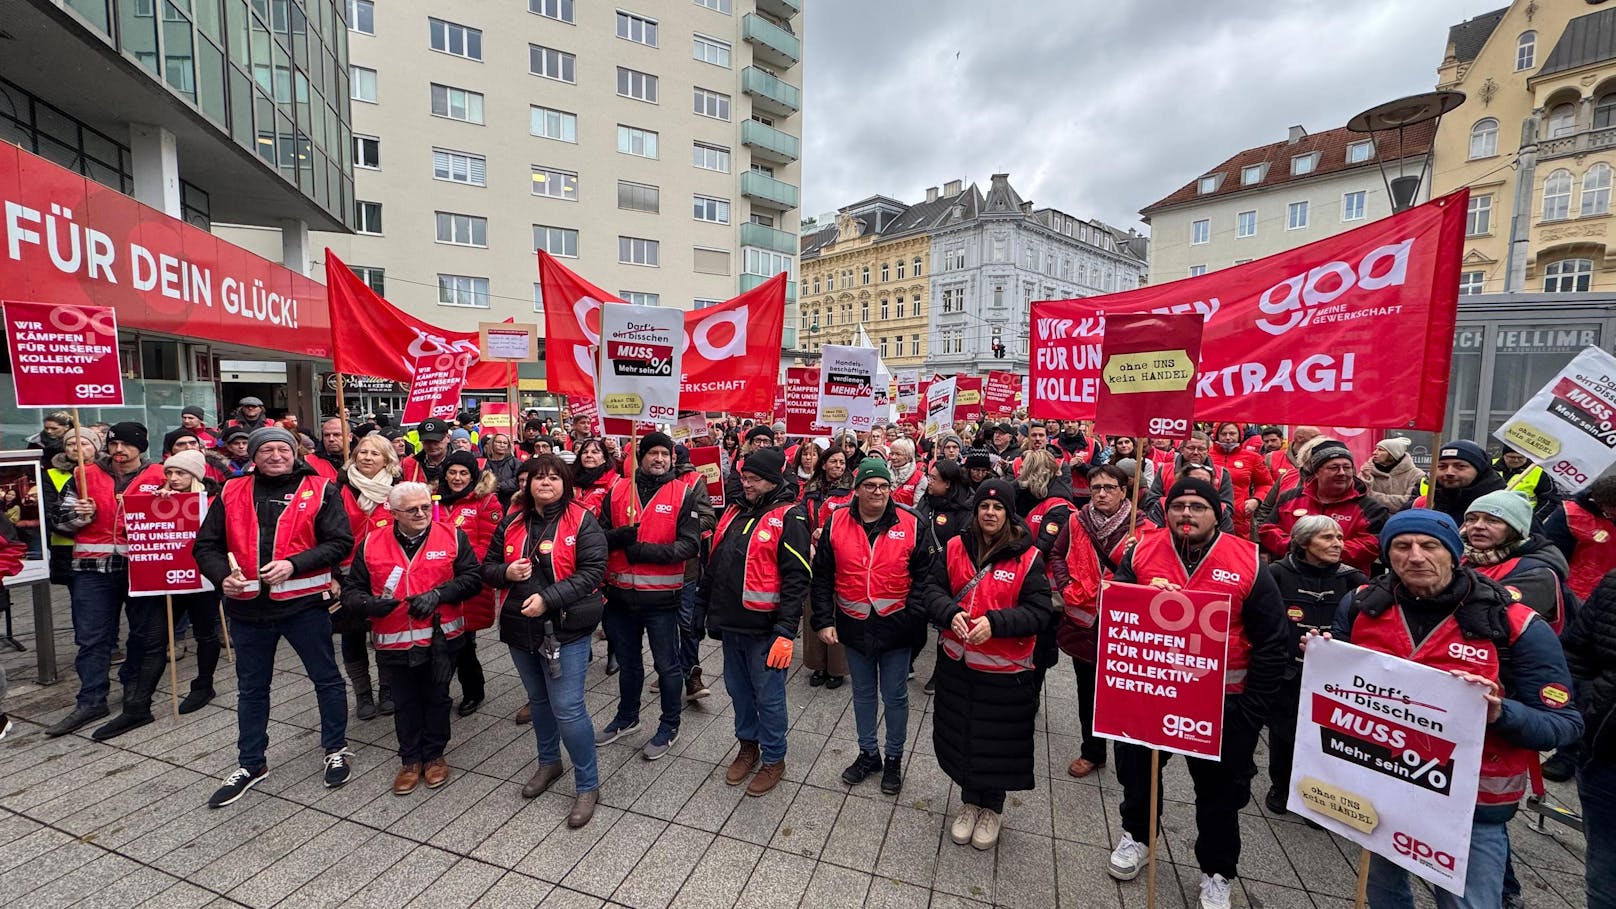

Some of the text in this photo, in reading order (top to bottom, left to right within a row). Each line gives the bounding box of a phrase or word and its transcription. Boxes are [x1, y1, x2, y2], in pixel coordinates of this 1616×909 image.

[5, 200, 299, 330] FÜR DEIN GLÜCK!
[1255, 238, 1416, 336] gpa
[1313, 305, 1402, 325] GEWERKSCHAFT
[1316, 304, 1347, 317] MEINE
[14, 321, 42, 330] WIR
[1037, 318, 1073, 341] WIR
[16, 331, 83, 342] KÄMPFEN
[629, 333, 669, 343] bisschen
[18, 342, 112, 353] FÜR UNSEREN
[617, 345, 653, 358] MUSS
[19, 354, 99, 363] KOLLEKTIV-
[1037, 342, 1069, 371] FÜR
[21, 366, 84, 374] VERTRAG
[618, 357, 671, 375] Mehr sein %
[830, 367, 869, 375] beschäftigte
[1119, 360, 1175, 371] ohne UNS
[417, 371, 448, 380] KÄMPFEN
[833, 376, 864, 384] verdienen
[1109, 371, 1188, 383] kein HANDEL
[415, 379, 428, 388] FÜR
[429, 377, 460, 386] UNSEREN
[679, 380, 746, 392] ERKSCHAFT
[787, 385, 818, 393] KÄMPFEN
[75, 384, 115, 398] gpa
[413, 385, 452, 395] KOLLEKTIV-
[831, 385, 858, 396] MEHR!
[858, 384, 872, 396] %
[412, 394, 442, 402] VERTRAG
[1566, 388, 1614, 420] MUSS
[432, 404, 454, 416] gpa
[649, 405, 674, 419] gpa
[852, 416, 869, 425] gpa
[1149, 418, 1187, 435] gpa
[1555, 404, 1579, 423] Mehr
[1579, 417, 1600, 438] sein
[1518, 427, 1536, 439] ohne
[1552, 460, 1588, 484] gpa
[461, 508, 477, 516] gpa
[655, 504, 672, 513] gpa
[126, 512, 146, 520] WIR
[127, 521, 175, 531] KÄMPFEN
[128, 531, 197, 541] FÜR UNSEREN
[888, 529, 905, 540] gpa
[128, 542, 187, 552] KOLLEKTIV-
[129, 553, 173, 562] VERTRAG
[426, 551, 446, 560] gpa
[166, 569, 195, 584] gpa
[993, 569, 1015, 583] gpa
[1211, 569, 1240, 583] gpa
[1109, 610, 1140, 625] WIR
[1108, 626, 1186, 649] KÄMPFEN
[1107, 642, 1219, 671] FÜR UNSEREN
[1448, 642, 1489, 661] gpa
[1106, 659, 1200, 684] KOLLEKTIV-
[1105, 675, 1177, 699] VERTRAG
[1353, 675, 1411, 705] Darf's
[1324, 683, 1444, 733] ein bisschen
[1162, 713, 1213, 739] gpa
[1330, 707, 1408, 750] MUSS
[1331, 737, 1448, 789] Mehr sein %
[1311, 786, 1361, 811] ohne UNS
[1302, 790, 1373, 826] kein HANDEL
[1392, 831, 1456, 871] gpa
